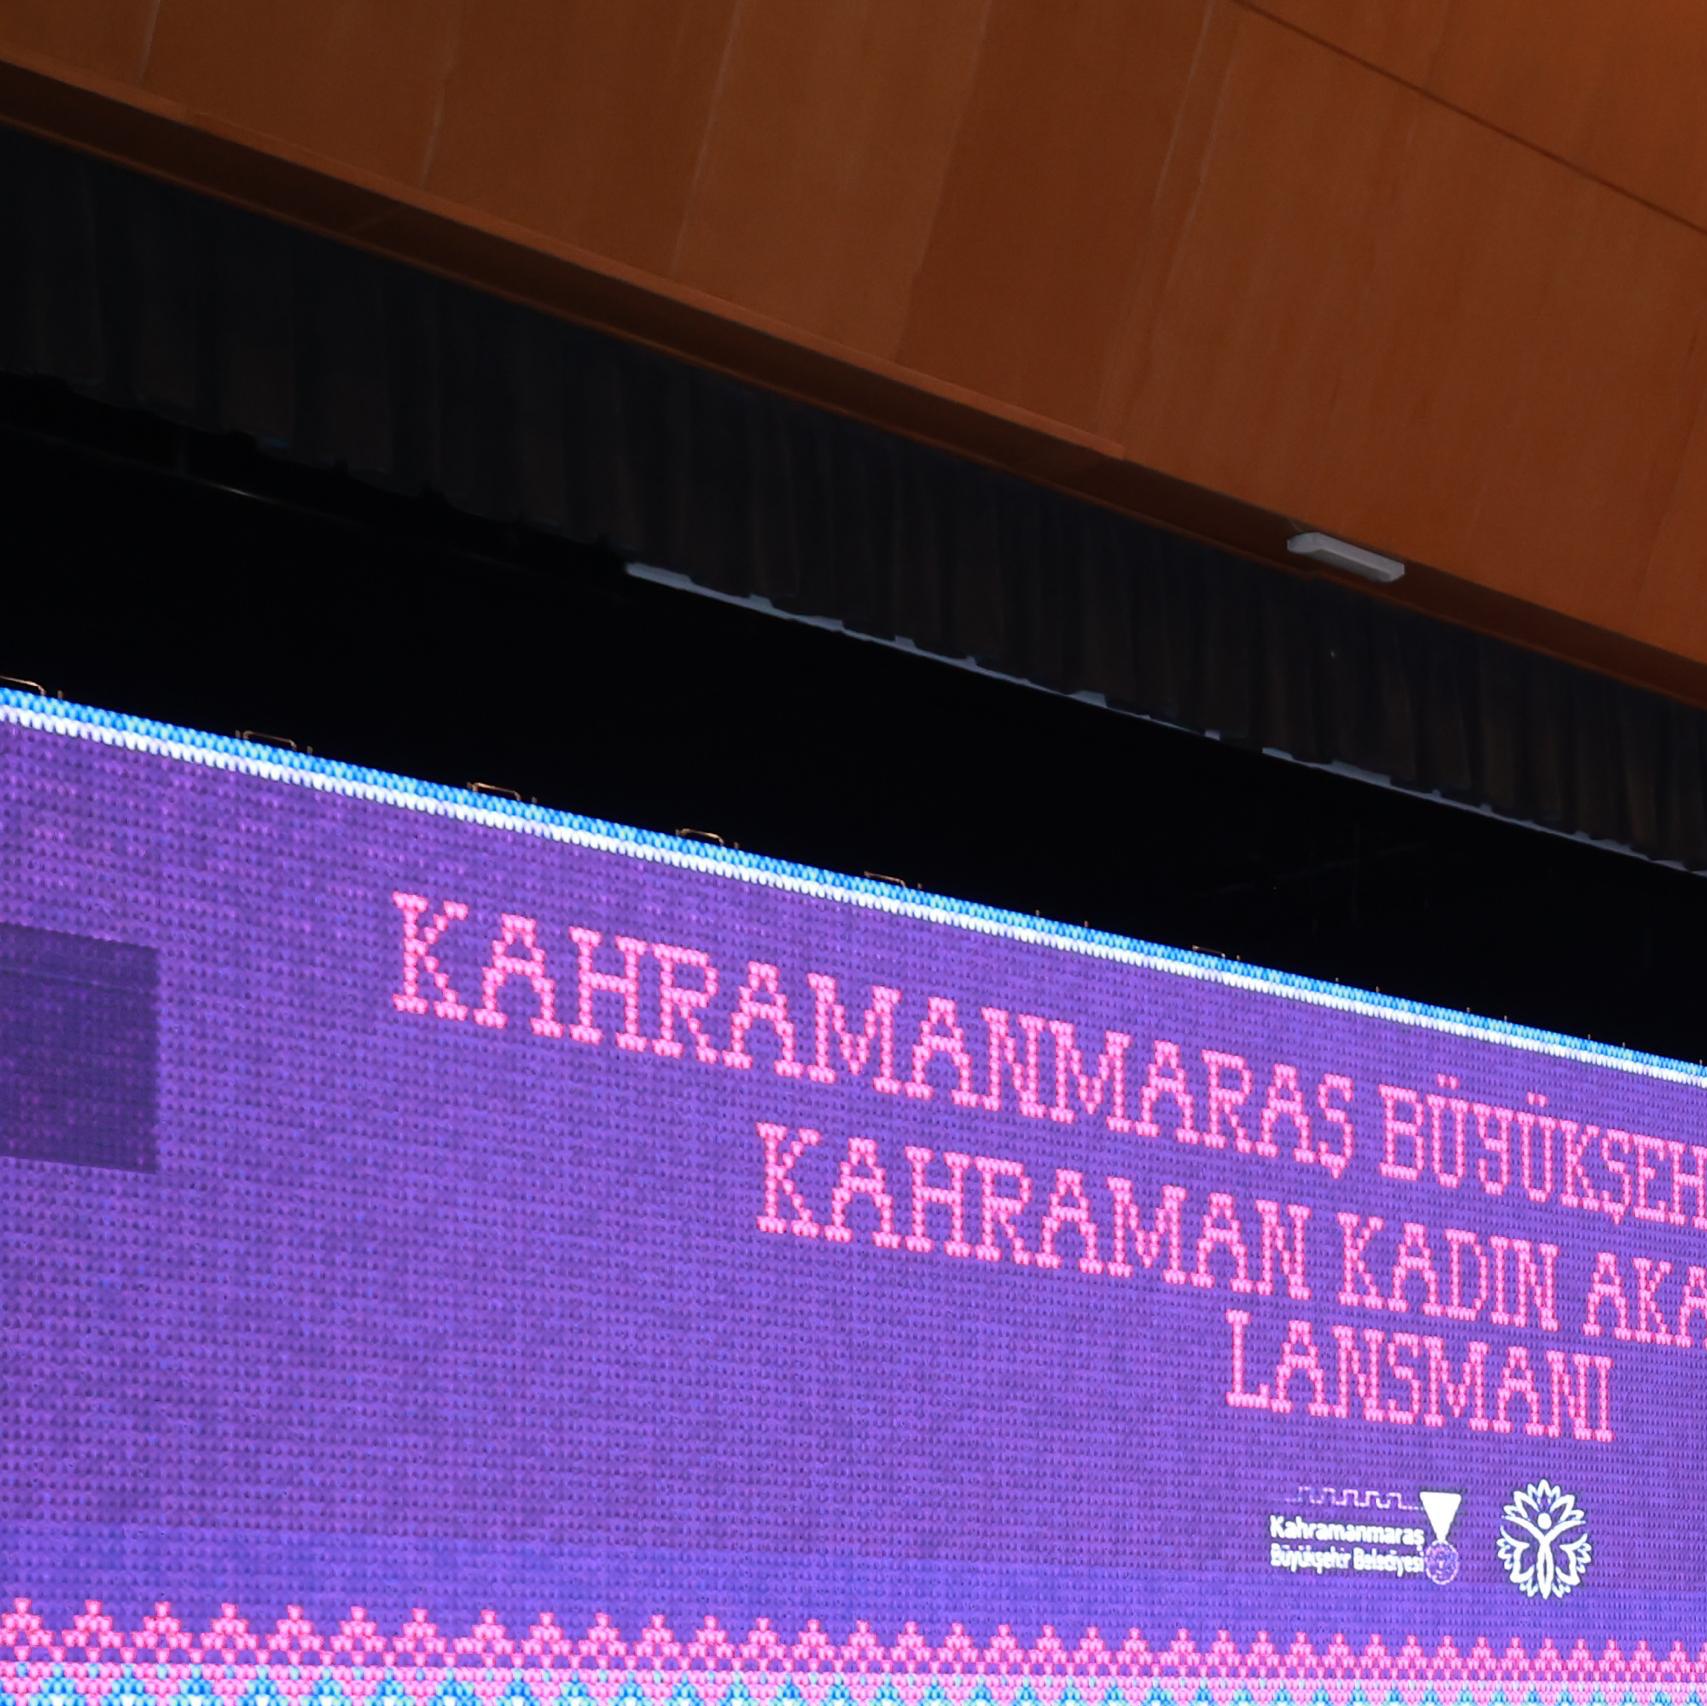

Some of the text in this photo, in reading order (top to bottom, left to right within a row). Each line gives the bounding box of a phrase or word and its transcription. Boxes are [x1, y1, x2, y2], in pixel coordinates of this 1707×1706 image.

[393, 892, 1353, 1179] KAHRAMANMARAŞ
[757, 1122, 1311, 1301] KAHRAMAN
[1337, 1212, 1559, 1332] KADIN
[1226, 1308, 1613, 1443] LANSMANI
[1269, 1514, 1425, 1553] Kahramanmaraş
